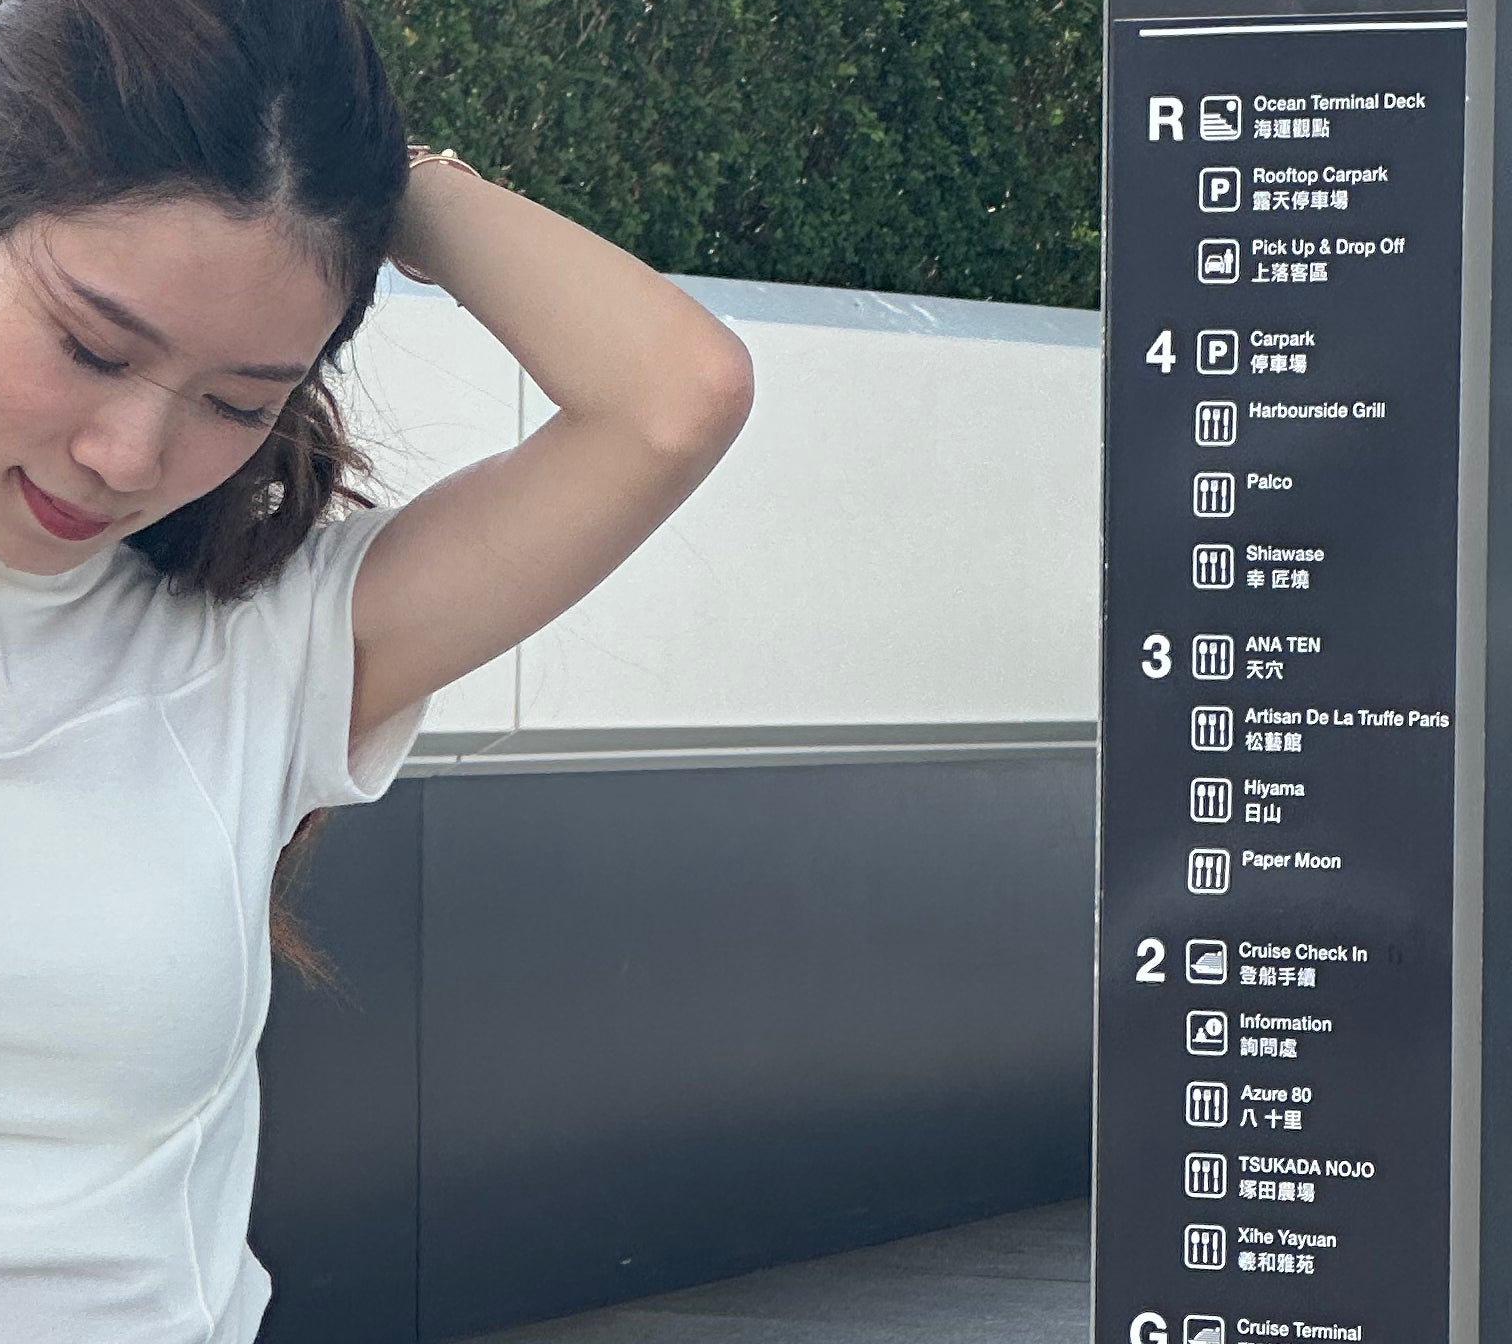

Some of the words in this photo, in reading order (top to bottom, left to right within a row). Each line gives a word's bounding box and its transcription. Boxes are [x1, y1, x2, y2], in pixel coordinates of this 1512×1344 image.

[1253, 95, 1307, 112] Ocean
[1310, 92, 1380, 111] Terminal
[1383, 92, 1426, 110] Deck
[1148, 96, 1184, 142] R
[1253, 117, 1331, 140] 海運觀點
[1253, 166, 1319, 187] Rooftop
[1322, 165, 1389, 186] Carpark
[1252, 189, 1349, 211] 露天停車場
[1251, 238, 1288, 256] Pick
[1291, 238, 1316, 259] Up
[1318, 238, 1332, 255] &
[1335, 238, 1376, 258] Drop
[1379, 237, 1406, 255] Off
[1250, 262, 1328, 283] 上落客區
[1250, 330, 1316, 350] Carpark
[1145, 329, 1177, 374] 4
[1249, 353, 1308, 374] 停車場
[1248, 401, 1349, 419] Harbourside
[1352, 401, 1386, 419] Grill
[1246, 472, 1293, 490] Palco
[1246, 544, 1325, 562] Shiawase
[1245, 635, 1283, 653] ANA
[1285, 636, 1321, 653] TEN
[1141, 634, 1173, 680] 3
[1246, 659, 1284, 680] 天穴
[1244, 707, 1302, 725] Artisan
[1306, 708, 1330, 726] De
[1333, 709, 1354, 726] La
[1357, 709, 1405, 727] Truffe
[1408, 710, 1450, 728] Paris
[1243, 778, 1306, 799] Hiyama
[1241, 850, 1292, 871] Paper
[1294, 851, 1342, 869] Moon
[1135, 936, 1166, 983] 2
[1238, 941, 1292, 960] Cruise
[1294, 943, 1348, 962] Check
[1352, 945, 1368, 963] In
[1239, 965, 1316, 988] 登船手續
[1239, 1012, 1333, 1032] Information
[1239, 1036, 1298, 1059] 詢問處
[1240, 1084, 1288, 1103] Azure
[1291, 1086, 1312, 1104] 80
[1238, 1155, 1322, 1176] TSUKADA
[1325, 1159, 1375, 1179] NOJO
[1237, 1226, 1274, 1245] Xihe
[1277, 1229, 1337, 1250] Yayuan
[1236, 1317, 1290, 1337] Cruise
[1292, 1321, 1362, 1342] Terminal
